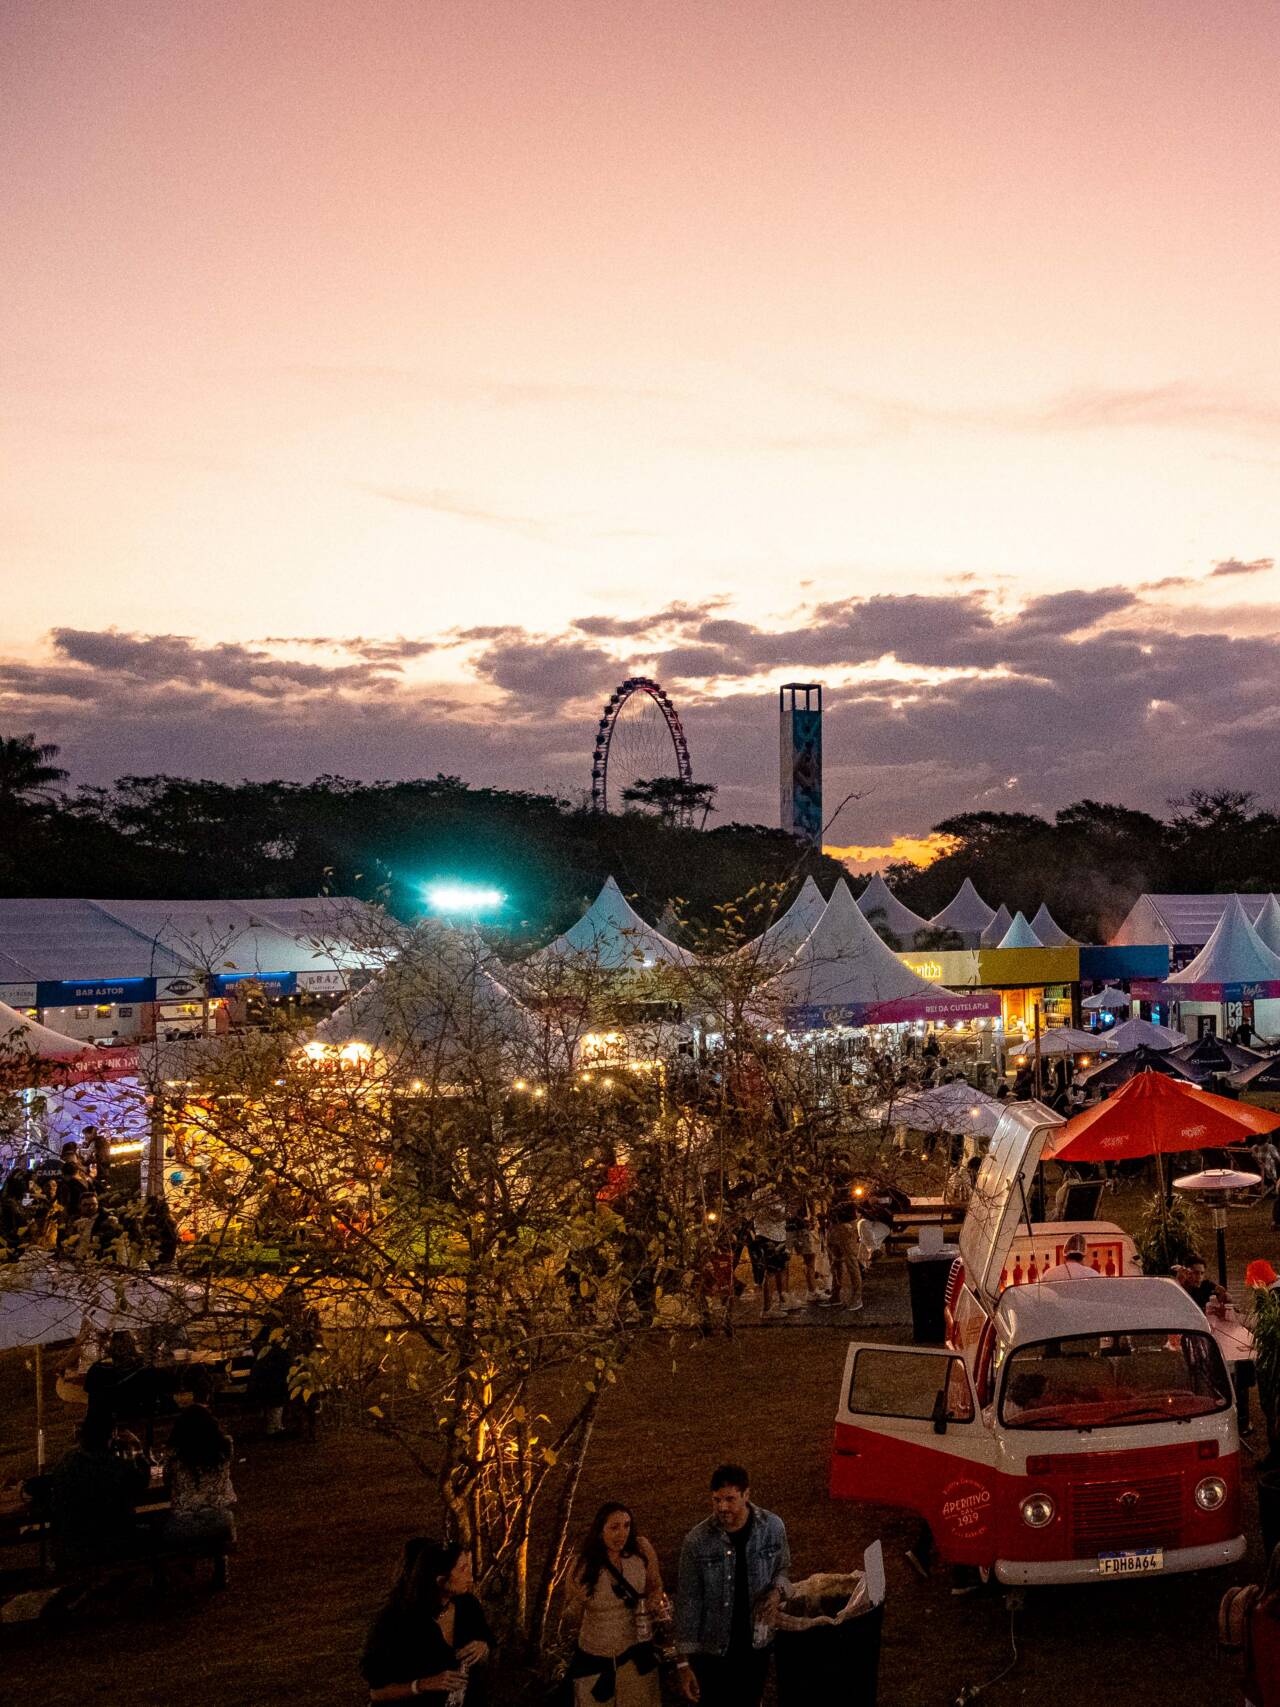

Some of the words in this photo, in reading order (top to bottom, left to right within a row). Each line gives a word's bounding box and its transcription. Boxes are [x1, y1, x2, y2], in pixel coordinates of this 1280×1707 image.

[925, 1005, 937, 1013] REI
[943, 1490, 990, 1515] APERITIVO
[958, 1512, 979, 1527] 1919
[1105, 1555, 1157, 1573] FDH8A64
